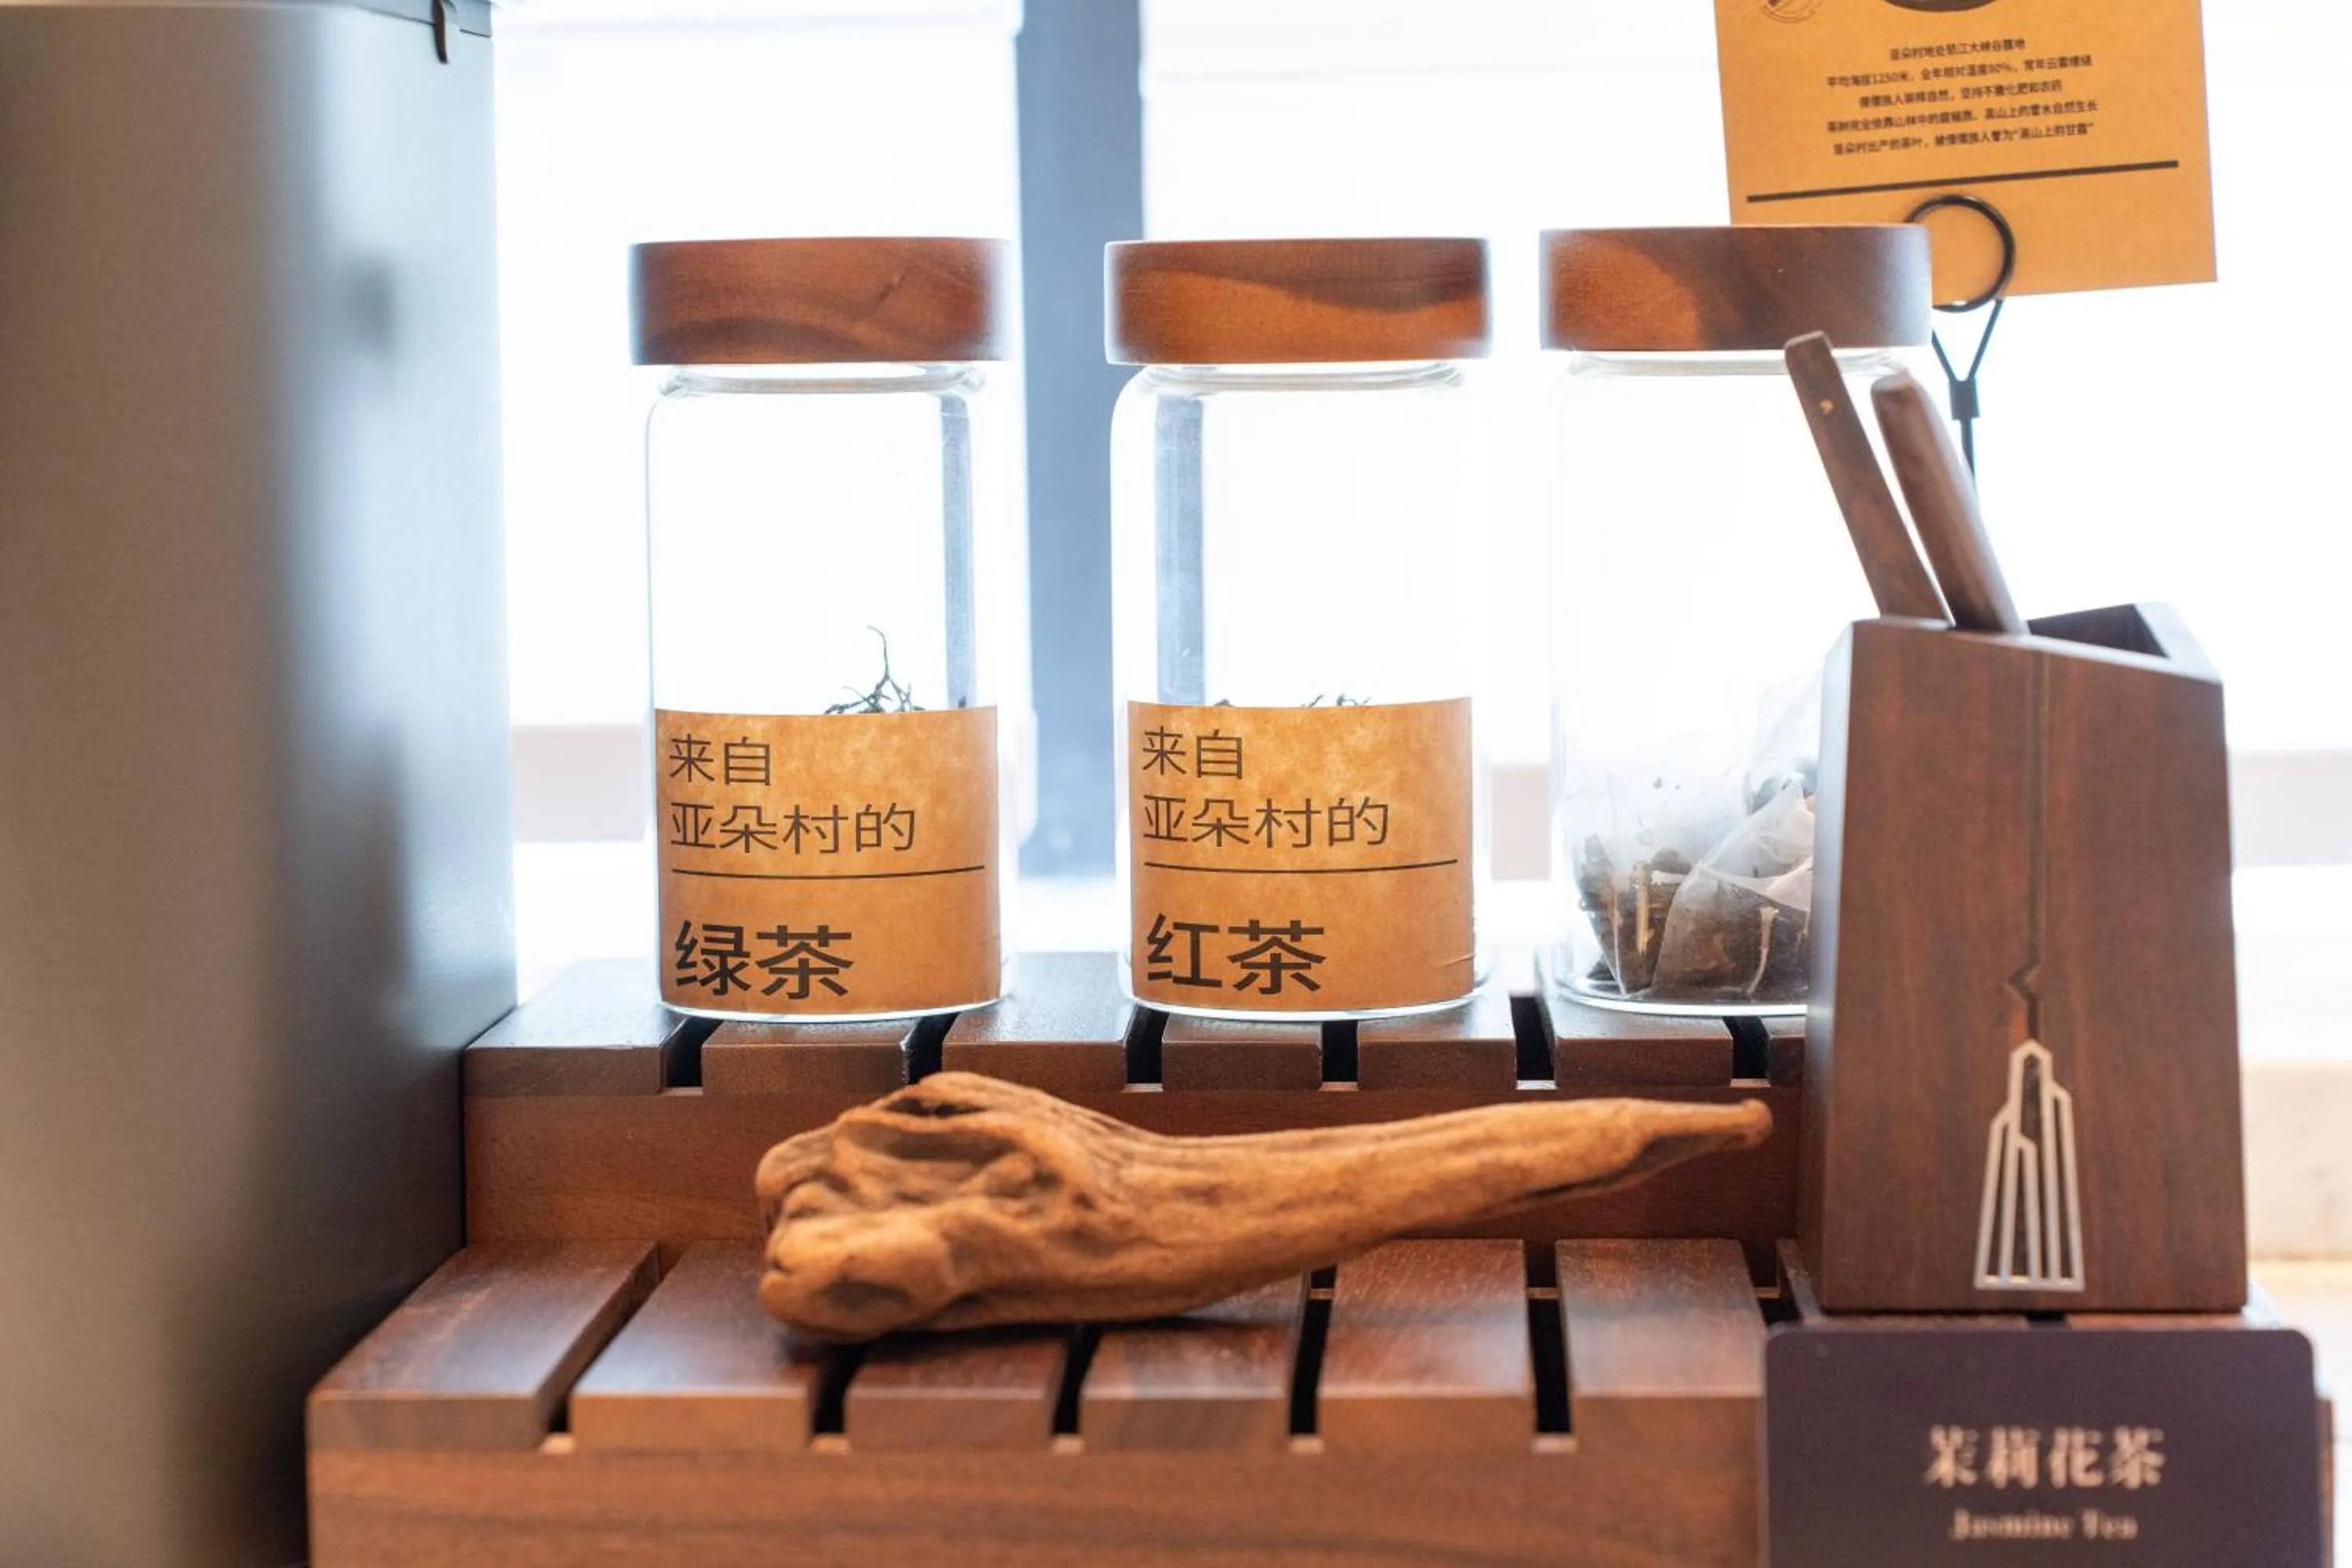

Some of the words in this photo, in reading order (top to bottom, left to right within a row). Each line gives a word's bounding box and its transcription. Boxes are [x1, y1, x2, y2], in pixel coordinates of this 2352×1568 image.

[669, 732, 771, 786] 来自
[1142, 725, 1243, 780] 来自
[670, 801, 916, 855] 亚朵村的
[1142, 794, 1388, 849] 亚朵村的
[675, 919, 855, 1000] 绿茶
[1146, 913, 1327, 995] 红茶
[1926, 1425, 2165, 1489] 茉莉花茶
[1950, 1508, 2074, 1541] Jasmine
[2082, 1508, 2139, 1541] Tea
